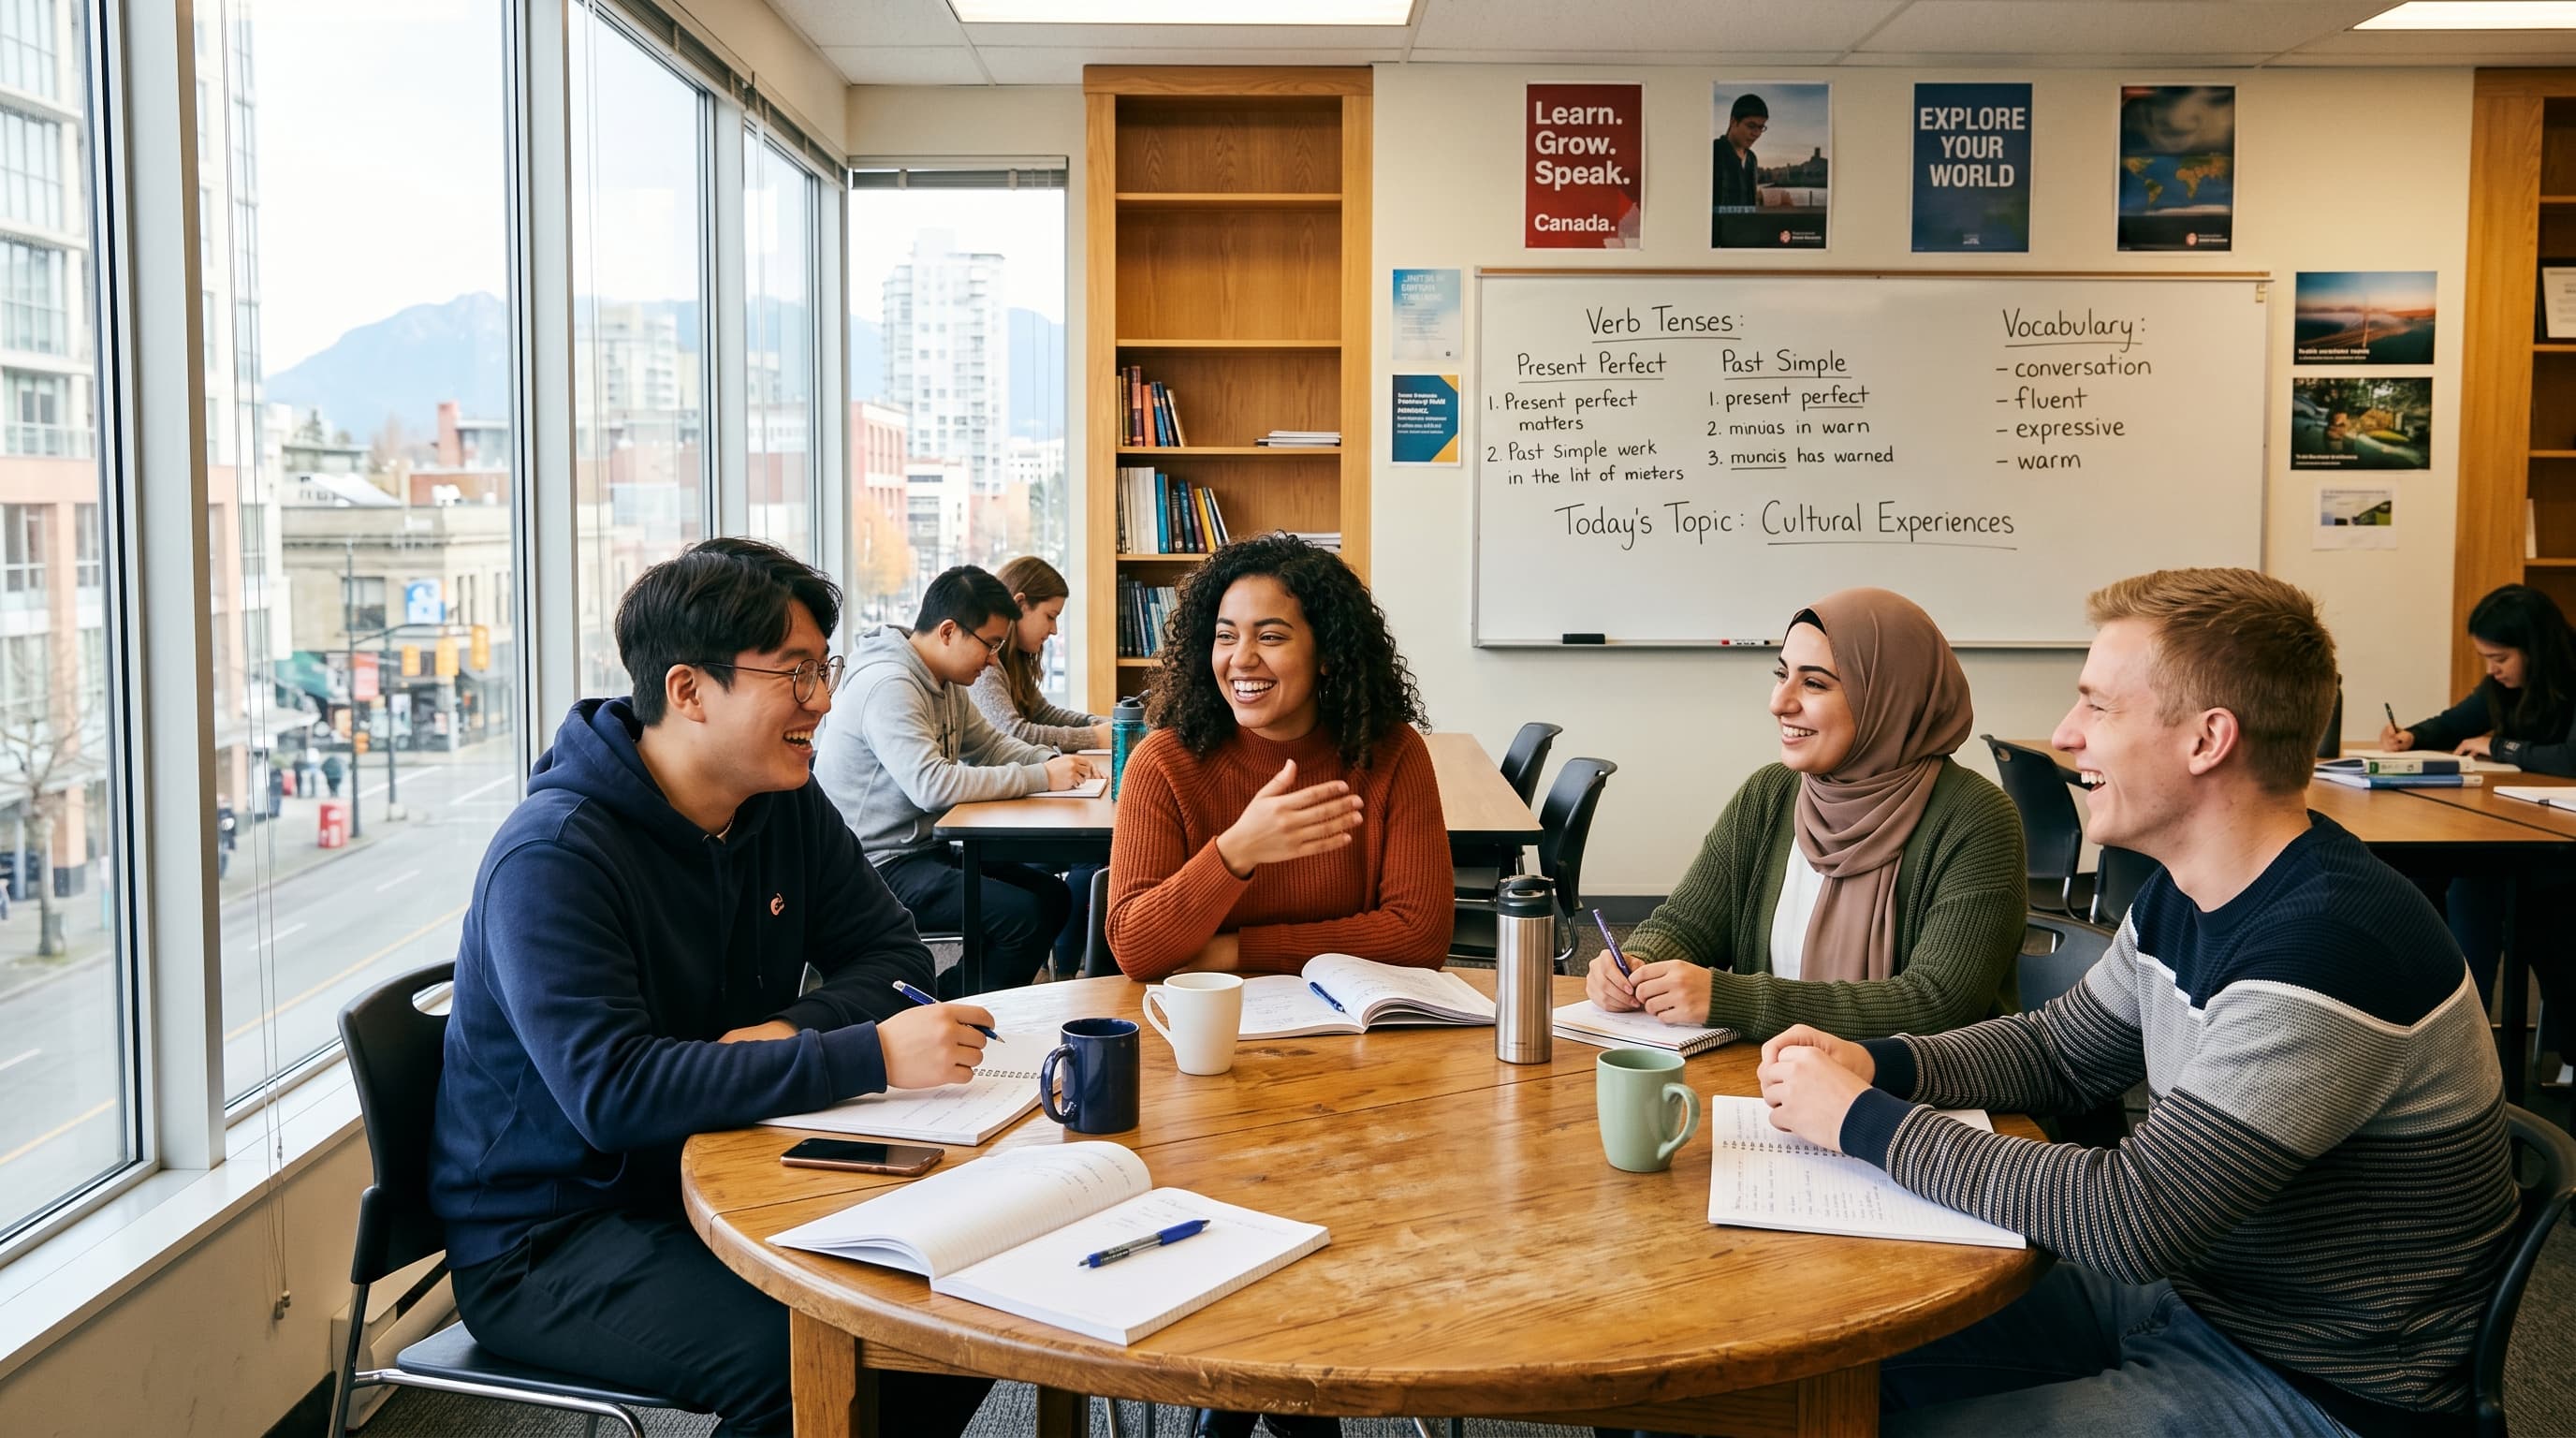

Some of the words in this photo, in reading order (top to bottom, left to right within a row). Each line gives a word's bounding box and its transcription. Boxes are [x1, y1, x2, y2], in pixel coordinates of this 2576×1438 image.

[1535, 100, 1623, 125] Learn.
[1920, 107, 2026, 131] EXPLORE
[1534, 130, 1617, 155] Grow.
[1940, 135, 2003, 159] YOUR
[1534, 160, 1631, 192] Speak.
[1929, 164, 2014, 188] WORLD
[1534, 213, 1616, 232] Canada.
[1586, 305, 1641, 335] Verb
[1516, 352, 1588, 376] Present
[1599, 350, 1668, 374] Perfect
[1721, 348, 1764, 374] Past
[1776, 348, 1848, 377] Simple
[2014, 351, 2152, 378] conversation
[1488, 394, 1500, 411] 1.
[1504, 391, 1567, 411] Present
[1574, 388, 1638, 411] perfect
[1709, 390, 1720, 407] 1.
[1725, 385, 1792, 413] present
[1801, 384, 1871, 413] perfect
[2013, 385, 2089, 410] fluent
[1518, 412, 1585, 432] matters
[1706, 420, 1722, 437] 2.
[1795, 419, 1812, 435] in
[1822, 421, 1870, 434] warn
[2015, 417, 2126, 446] expressive
[1486, 446, 1503, 463] 2.
[1508, 441, 1545, 462] Past
[1553, 438, 1608, 465] Simple
[1707, 449, 1723, 467] 3.
[1796, 446, 1825, 463] has
[1834, 444, 1895, 463] warned
[2017, 453, 2082, 471] warm
[1508, 469, 1524, 486] in
[1530, 467, 1561, 485] the
[1599, 463, 1617, 482] of
[1553, 503, 1653, 551] Today's
[1762, 499, 1862, 536] Cultural
[1878, 500, 2015, 544] Experiences
